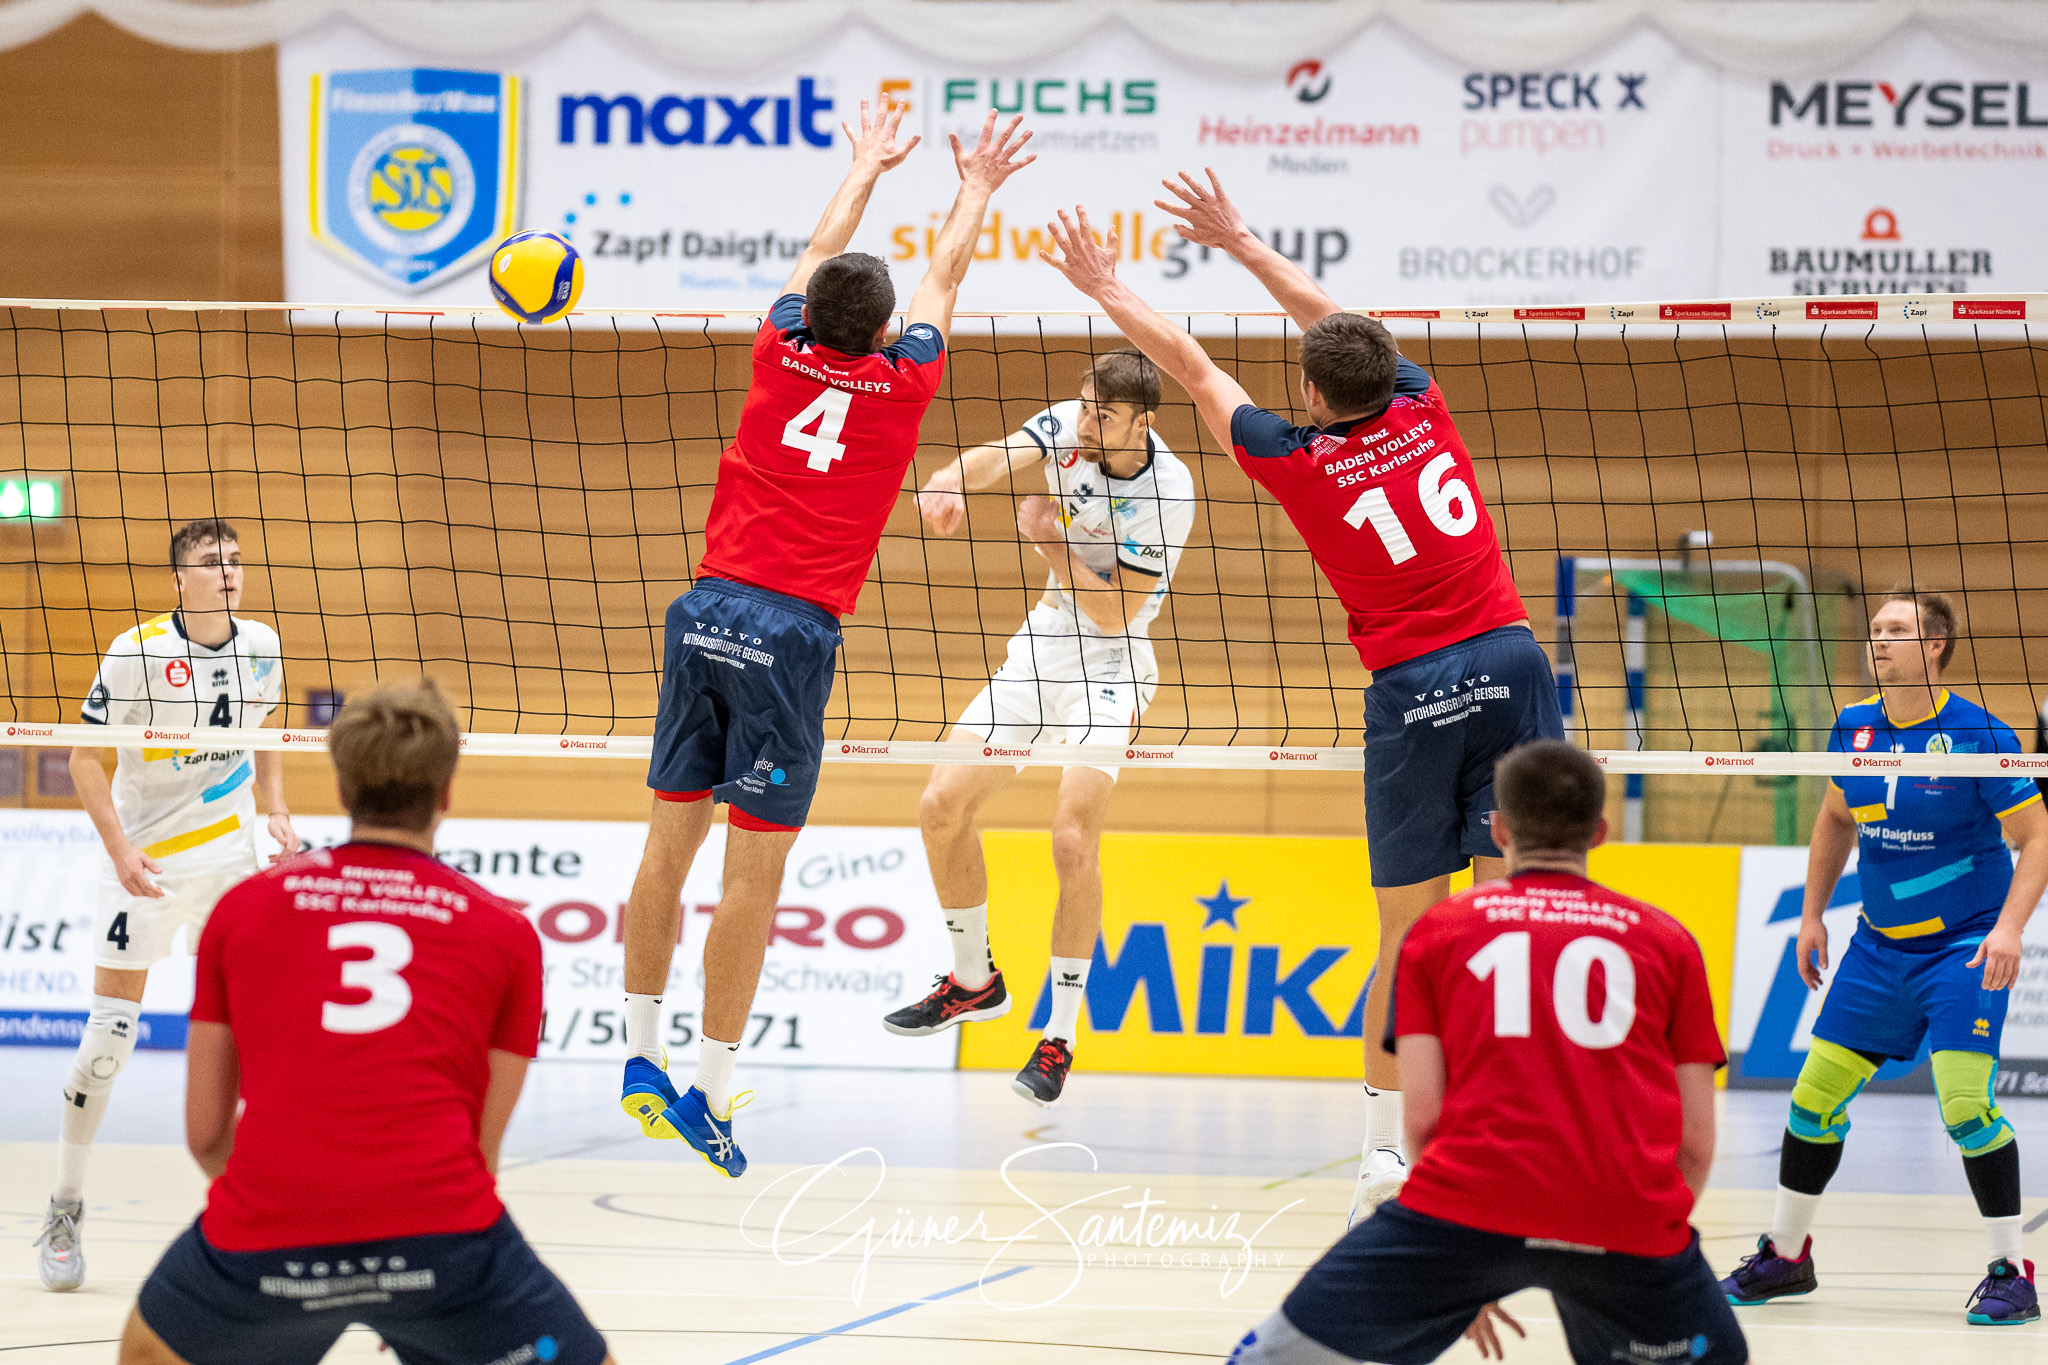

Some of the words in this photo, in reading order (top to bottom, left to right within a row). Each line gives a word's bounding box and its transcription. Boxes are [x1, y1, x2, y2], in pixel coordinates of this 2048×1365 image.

[943, 79, 1157, 114] FUCHS
[1462, 72, 1598, 111] SPECK
[1769, 81, 2048, 127] MEYSEL
[557, 76, 833, 148] maxit
[1199, 116, 1421, 147] Heinzelmann
[1461, 118, 1605, 156] pumpen
[592, 229, 671, 266] Zapf
[1400, 246, 1645, 281] BROCKERHOF
[1472, 310, 1489, 319] Zapf
[1528, 309, 1555, 318] Sparkasse
[1556, 308, 1580, 318] Nürnberg
[1617, 309, 1634, 318] Zapf
[1674, 309, 1699, 318] Sparkasse
[1701, 308, 1727, 318] Nürnberg
[1763, 308, 1780, 318] Zapf
[1820, 307, 1847, 316] Sparkasse
[1848, 307, 1873, 317] Nürnberg
[1910, 307, 1927, 317] Zapf
[1968, 307, 1994, 316] Sparkasse
[1995, 306, 2021, 317] Nürnberg
[781, 356, 826, 382] BADEN
[829, 378, 891, 393] VOLLEYS
[781, 387, 853, 473] 4
[1361, 428, 1389, 446] BENZ
[1324, 451, 1375, 476] BADEN
[1376, 419, 1432, 456] VOLLEYS
[1337, 470, 1367, 488] SSC
[1369, 438, 1436, 478] Karlsruhe
[1342, 451, 1478, 566] 16
[695, 621, 762, 646] VOLVO
[682, 632, 744, 657] AUTHAUSGRUPPE
[742, 646, 775, 668] GEISSER
[1415, 674, 1491, 702] VOLVO
[1474, 686, 1510, 701] GEISSER
[209, 693, 232, 728] 4
[17, 727, 53, 737] Marmot
[154, 731, 191, 740] Marmot
[292, 734, 329, 743] Marmot
[570, 740, 607, 750] Marmot
[852, 745, 889, 754] Marmot
[993, 748, 1031, 757] Marmot
[1137, 750, 1174, 759] Marmot
[1280, 752, 1318, 761] Marmot
[1716, 757, 1755, 766] Marmot
[1863, 758, 1902, 767] Marmot
[1882, 828, 1935, 843] Daigfuss
[798, 847, 905, 888] Gino
[0, 912, 71, 951] ist
[107, 911, 129, 951] 4
[321, 921, 414, 1035] 3
[1466, 931, 1637, 1050] 10
